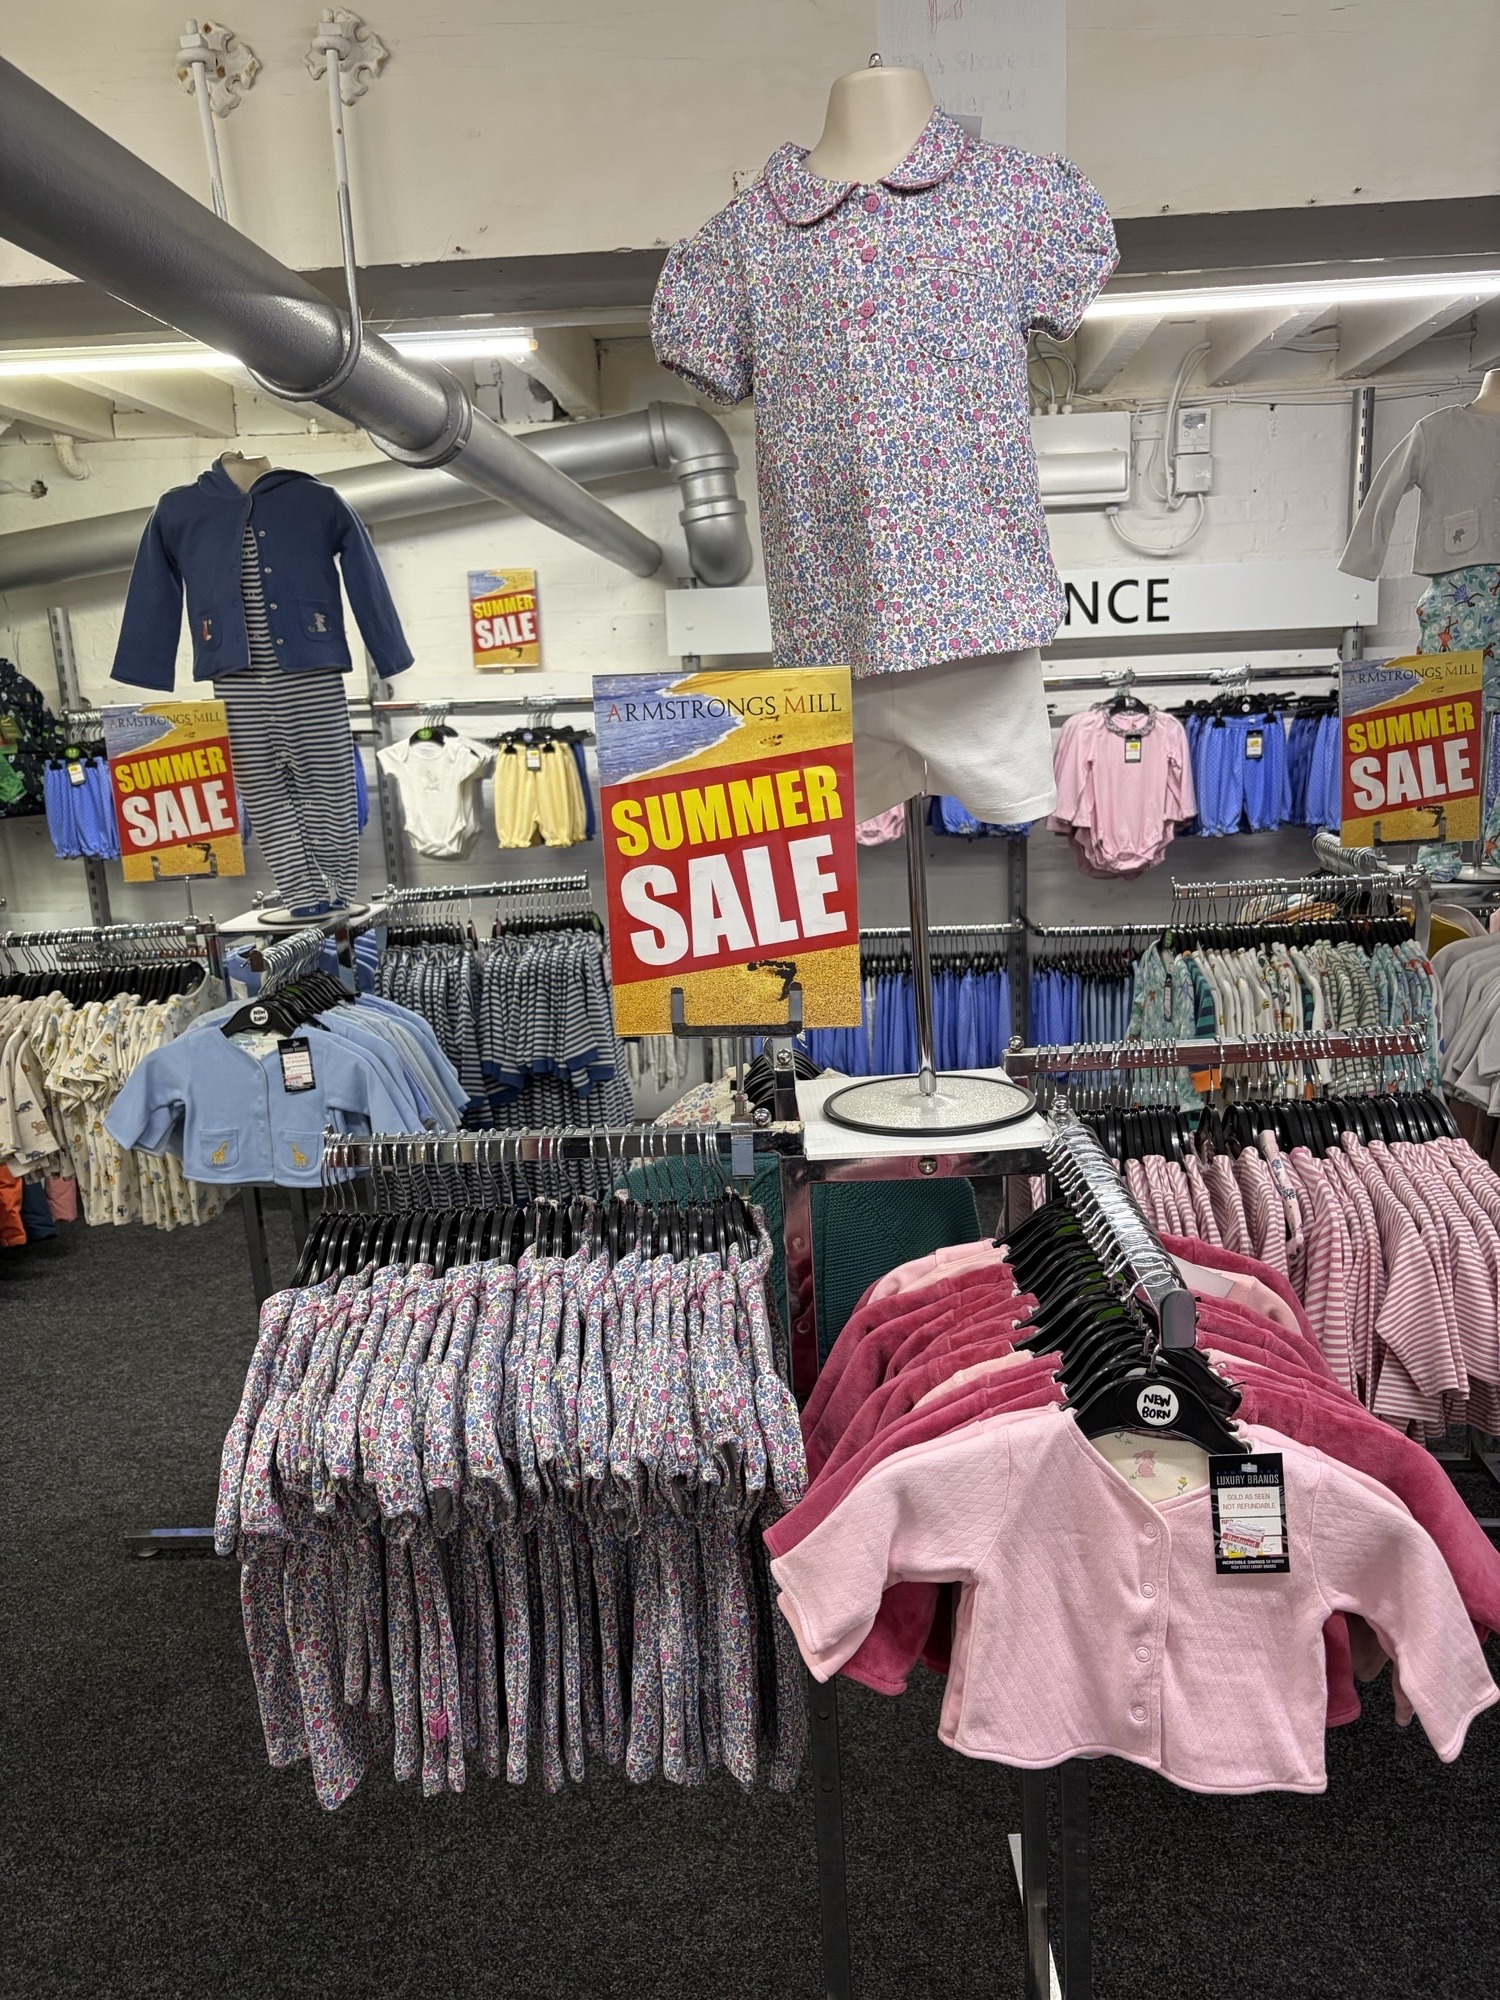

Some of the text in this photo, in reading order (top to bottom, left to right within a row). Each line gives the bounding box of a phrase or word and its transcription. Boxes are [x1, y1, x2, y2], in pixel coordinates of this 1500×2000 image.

[473, 594, 534, 619] SUMMER
[1064, 579, 1170, 626] NCE
[475, 612, 536, 649] SALE
[1349, 664, 1478, 684] ARMSTRONGS MILL
[109, 712, 222, 729] ARMSTRONGS MILL
[606, 694, 842, 723] ARMSTRONGS MILL
[1347, 701, 1475, 754] SUMMER
[115, 746, 227, 794] SUMMER
[1350, 737, 1474, 811] SALE
[122, 780, 235, 847] SALE
[610, 765, 843, 857] SUMMER
[620, 834, 848, 967] SALE
[1142, 1406, 1172, 1420] BORN
[1143, 1394, 1172, 1407] NEW
[1216, 1474, 1279, 1485] LUXURY BRANDS
[1236, 1502, 1276, 1510] REFUNDABLE
